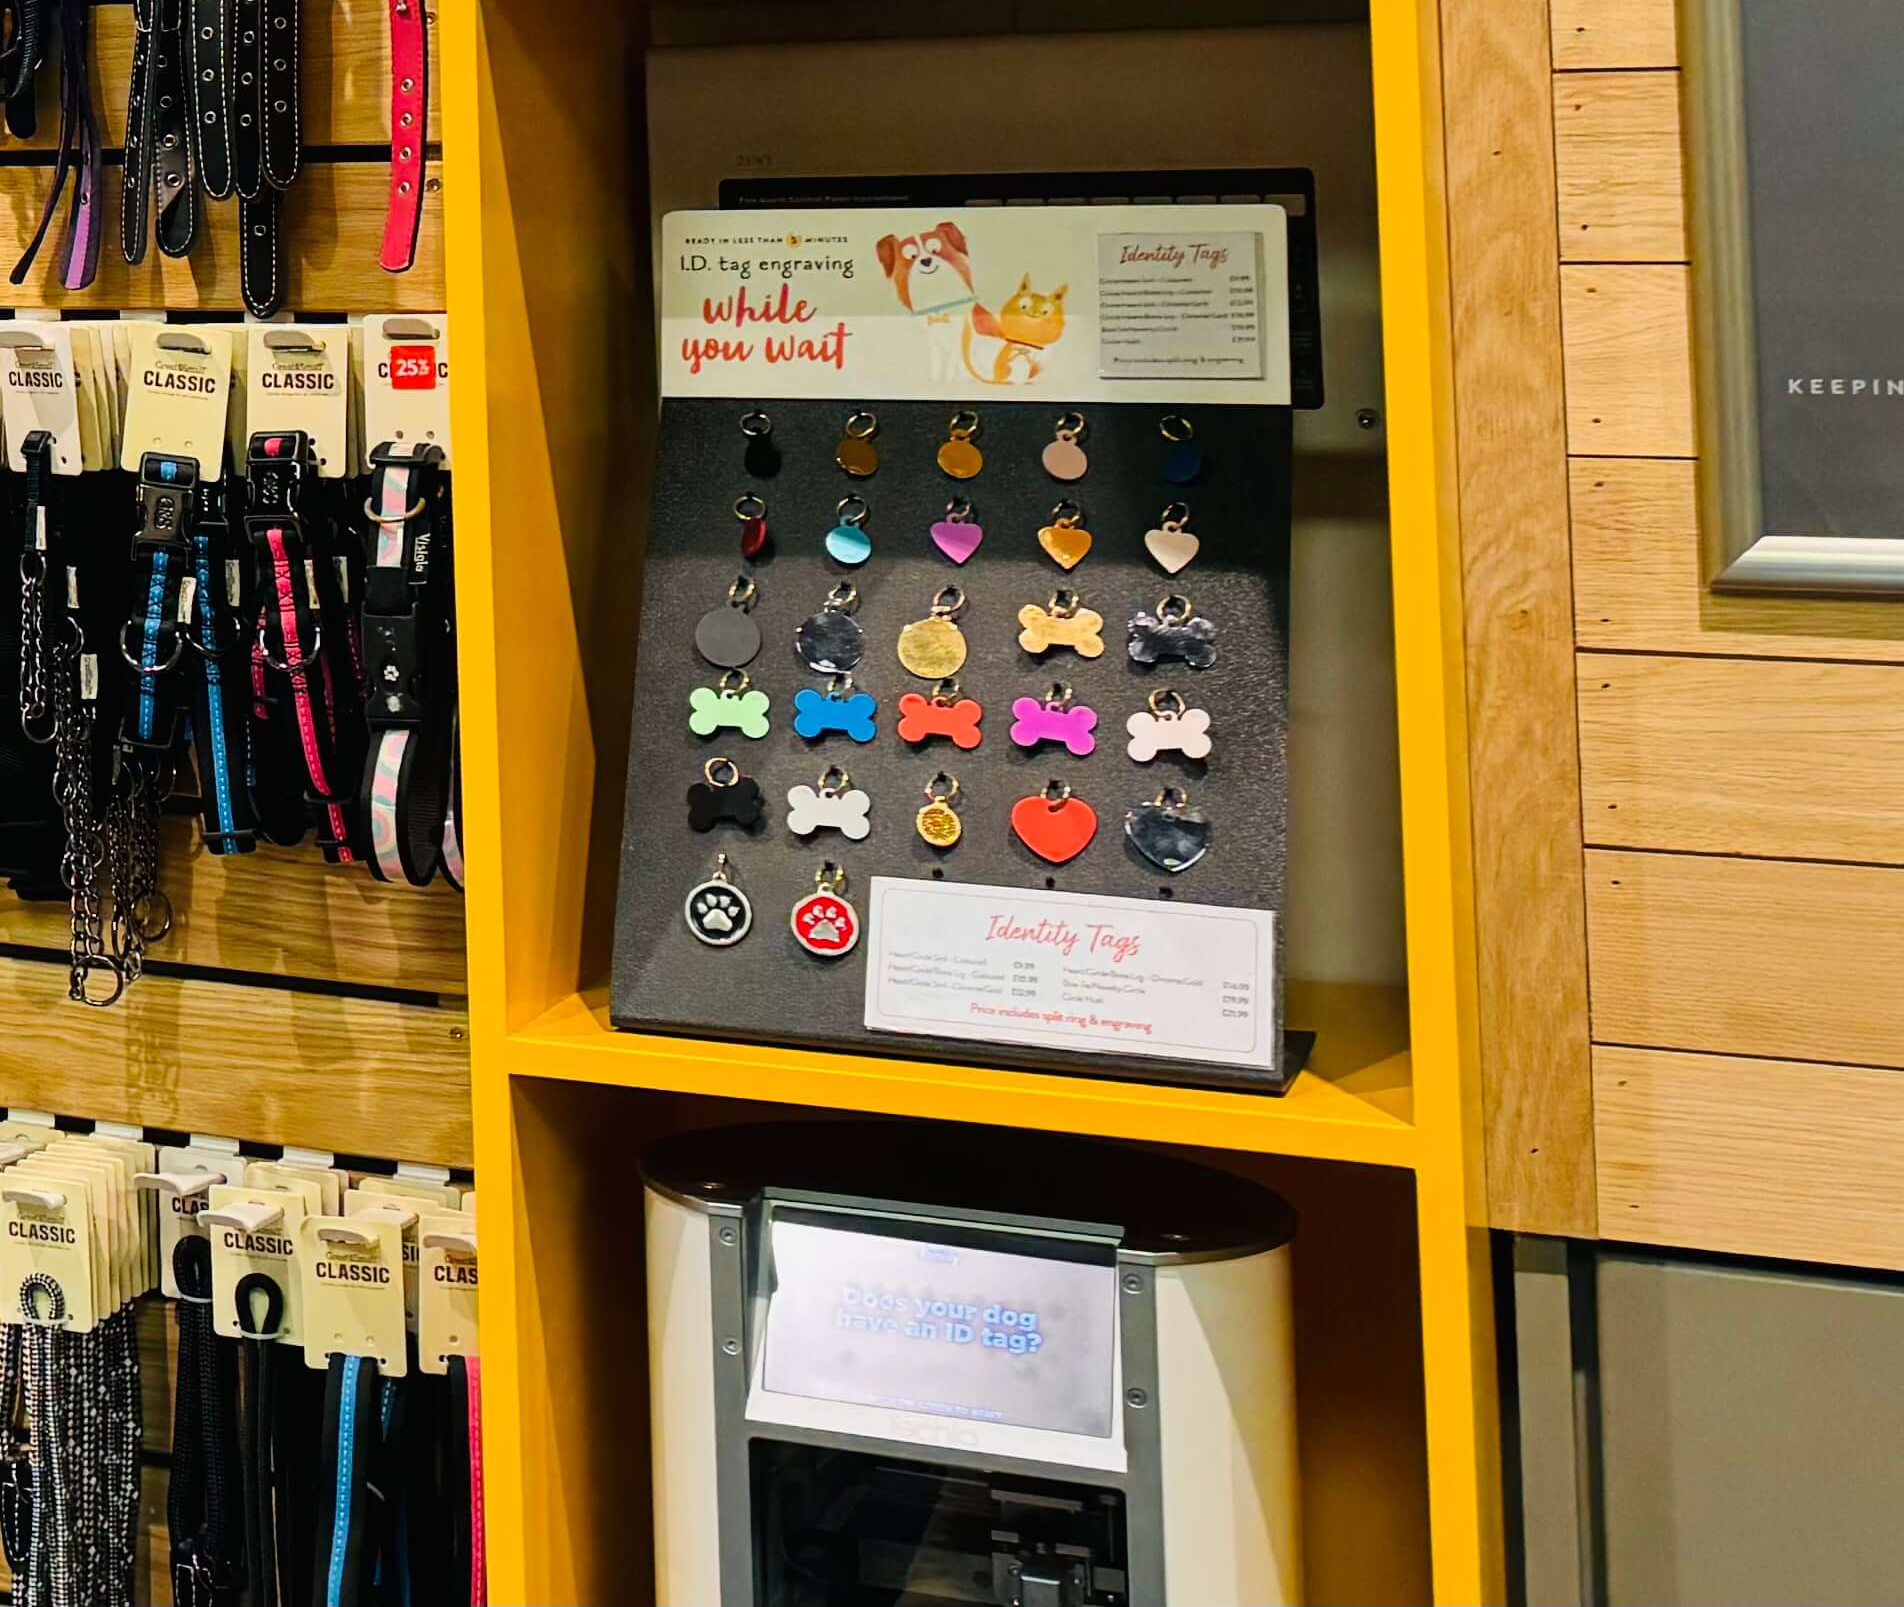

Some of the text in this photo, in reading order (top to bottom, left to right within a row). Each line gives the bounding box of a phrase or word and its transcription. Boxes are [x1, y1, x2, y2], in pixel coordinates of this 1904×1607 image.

[681, 255, 854, 279] I.D. tag engraving
[1120, 243, 1229, 269] Identity Tags
[703, 282, 817, 327] while
[681, 322, 853, 375] you wait
[9, 371, 63, 389] CLASSIC
[143, 370, 217, 394] CLASSIC
[262, 373, 335, 391] CLASSIC
[984, 914, 1141, 963] Identity Tags
[9, 1221, 76, 1244] CLASSIC
[223, 1232, 293, 1256] CLASSIC
[315, 1262, 390, 1284] CLASSIC
[842, 1288, 1038, 1331] Does your dog
[904, 1320, 936, 1340] an
[946, 1323, 973, 1343] ID
[981, 1327, 1043, 1354] tag?
